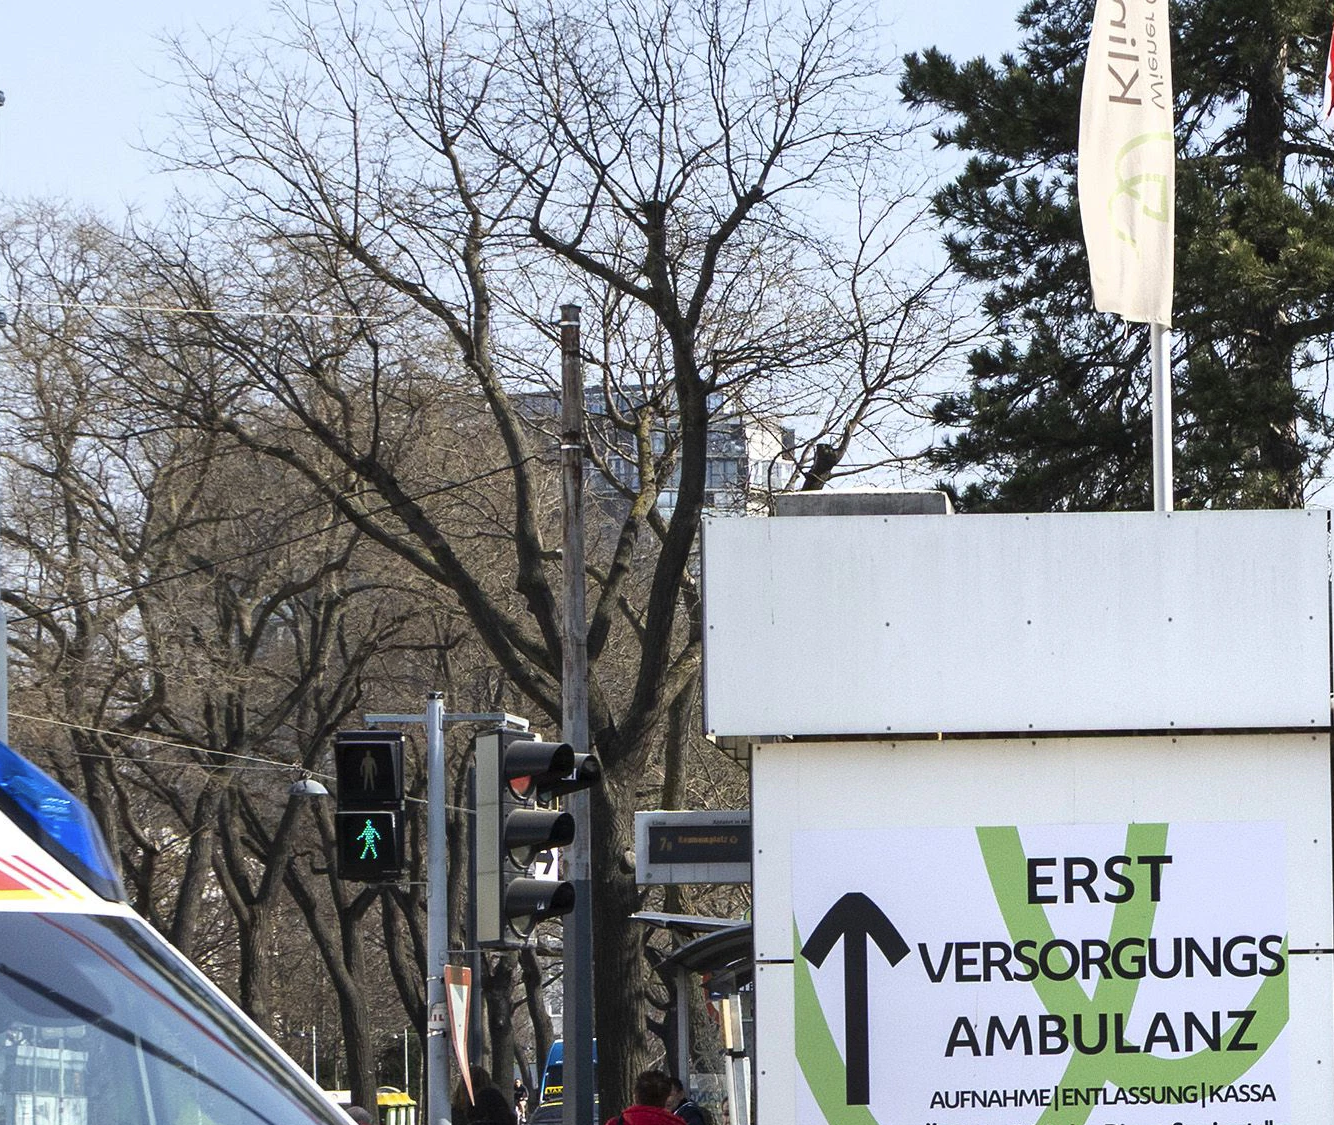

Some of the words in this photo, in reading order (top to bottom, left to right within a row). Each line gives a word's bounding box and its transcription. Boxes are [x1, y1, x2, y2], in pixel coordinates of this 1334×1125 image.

[1145, 12, 1165, 110] Wiener
[1027, 856, 1173, 905] ERST
[917, 935, 1286, 983] VERSORGUNGS
[944, 1010, 1259, 1058] AMBULANZ
